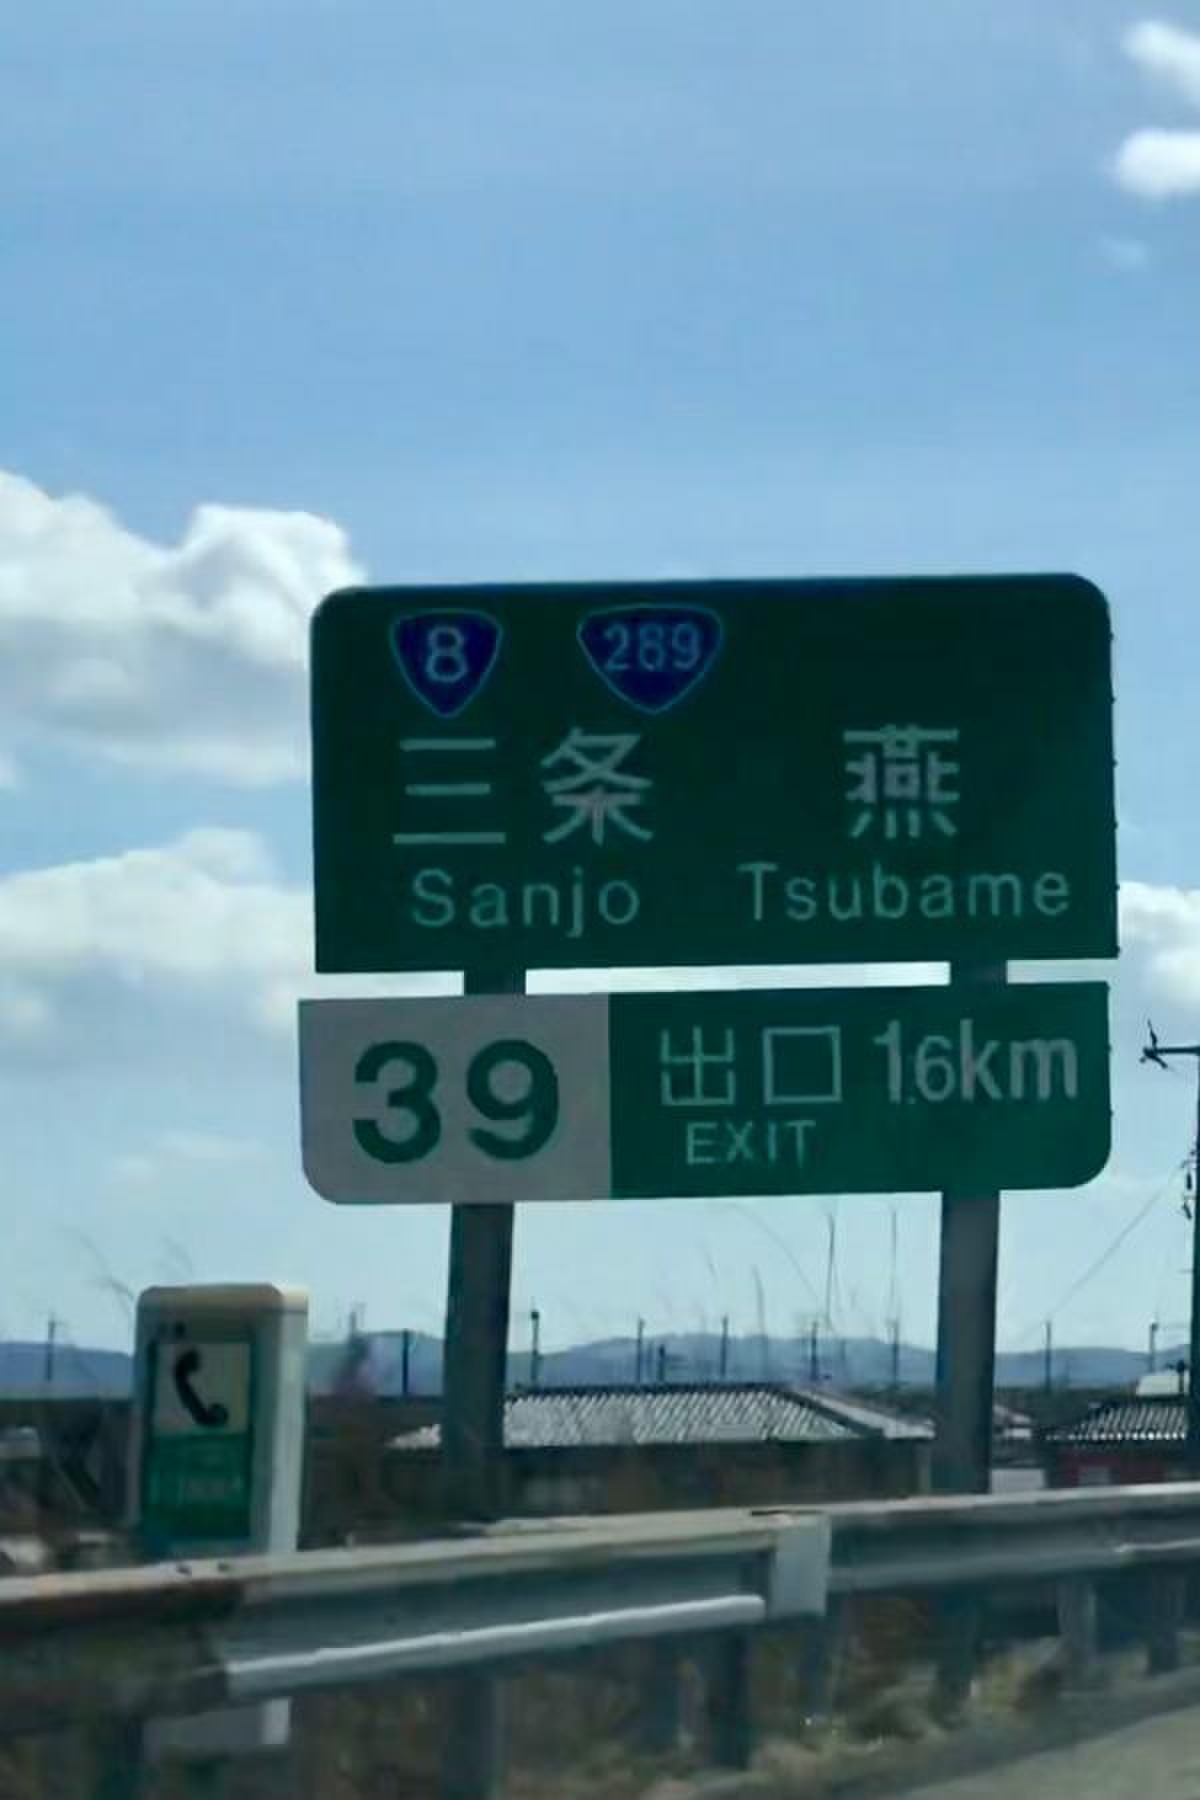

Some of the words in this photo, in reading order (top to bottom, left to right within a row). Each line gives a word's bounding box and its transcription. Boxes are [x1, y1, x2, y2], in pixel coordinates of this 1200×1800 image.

[424, 624, 470, 684] 8
[392, 726, 655, 846] 三条
[842, 722, 960, 840] 燕
[411, 868, 641, 937] Sanjo
[738, 861, 1071, 922] Tsubame
[351, 1038, 560, 1165] 39
[658, 1024, 844, 1108] 出口
[684, 1119, 816, 1167] EXIT
